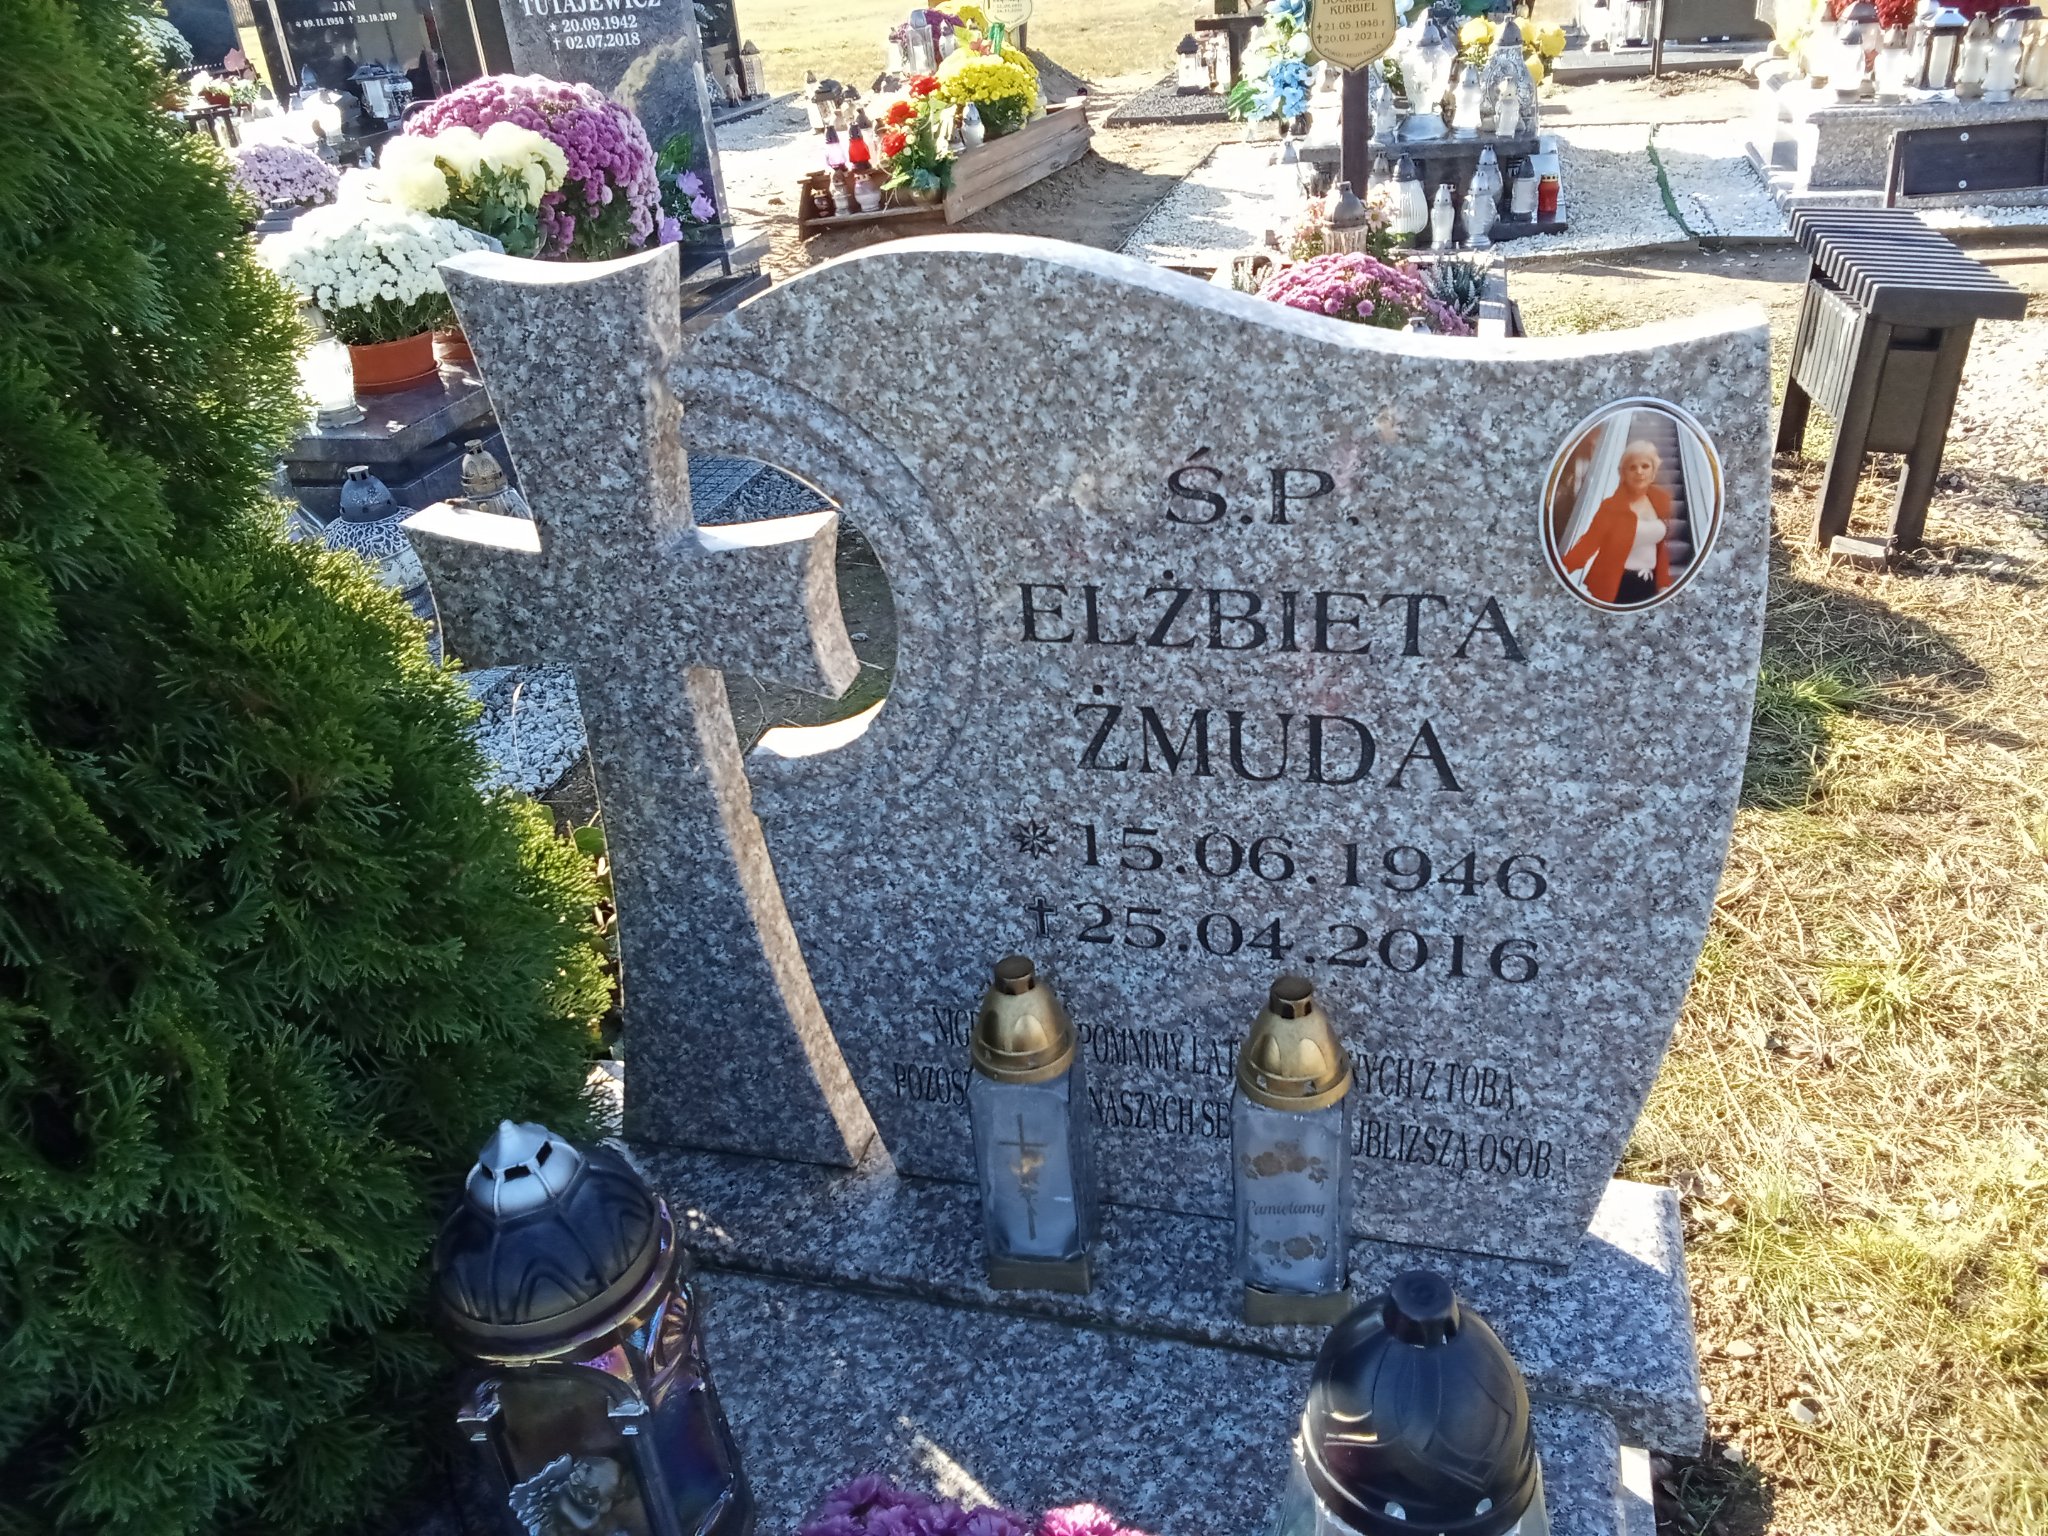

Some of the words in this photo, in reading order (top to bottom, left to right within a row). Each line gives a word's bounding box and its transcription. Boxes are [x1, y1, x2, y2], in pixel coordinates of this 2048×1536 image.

[561, 14, 638, 33] 20.09.1942
[565, 32, 641, 50] 02.07.2018
[1018, 569, 1528, 662] ELŻBIETA
[1073, 683, 1465, 793] ŻMUDA
[1082, 824, 1548, 901] 15.06.1946
[1077, 902, 1541, 984] 25.04.2016
[932, 1007, 977, 1048] NIG
[1078, 1022, 1185, 1072] POMNIMY
[1088, 1086, 1195, 1135] NASZYCH
